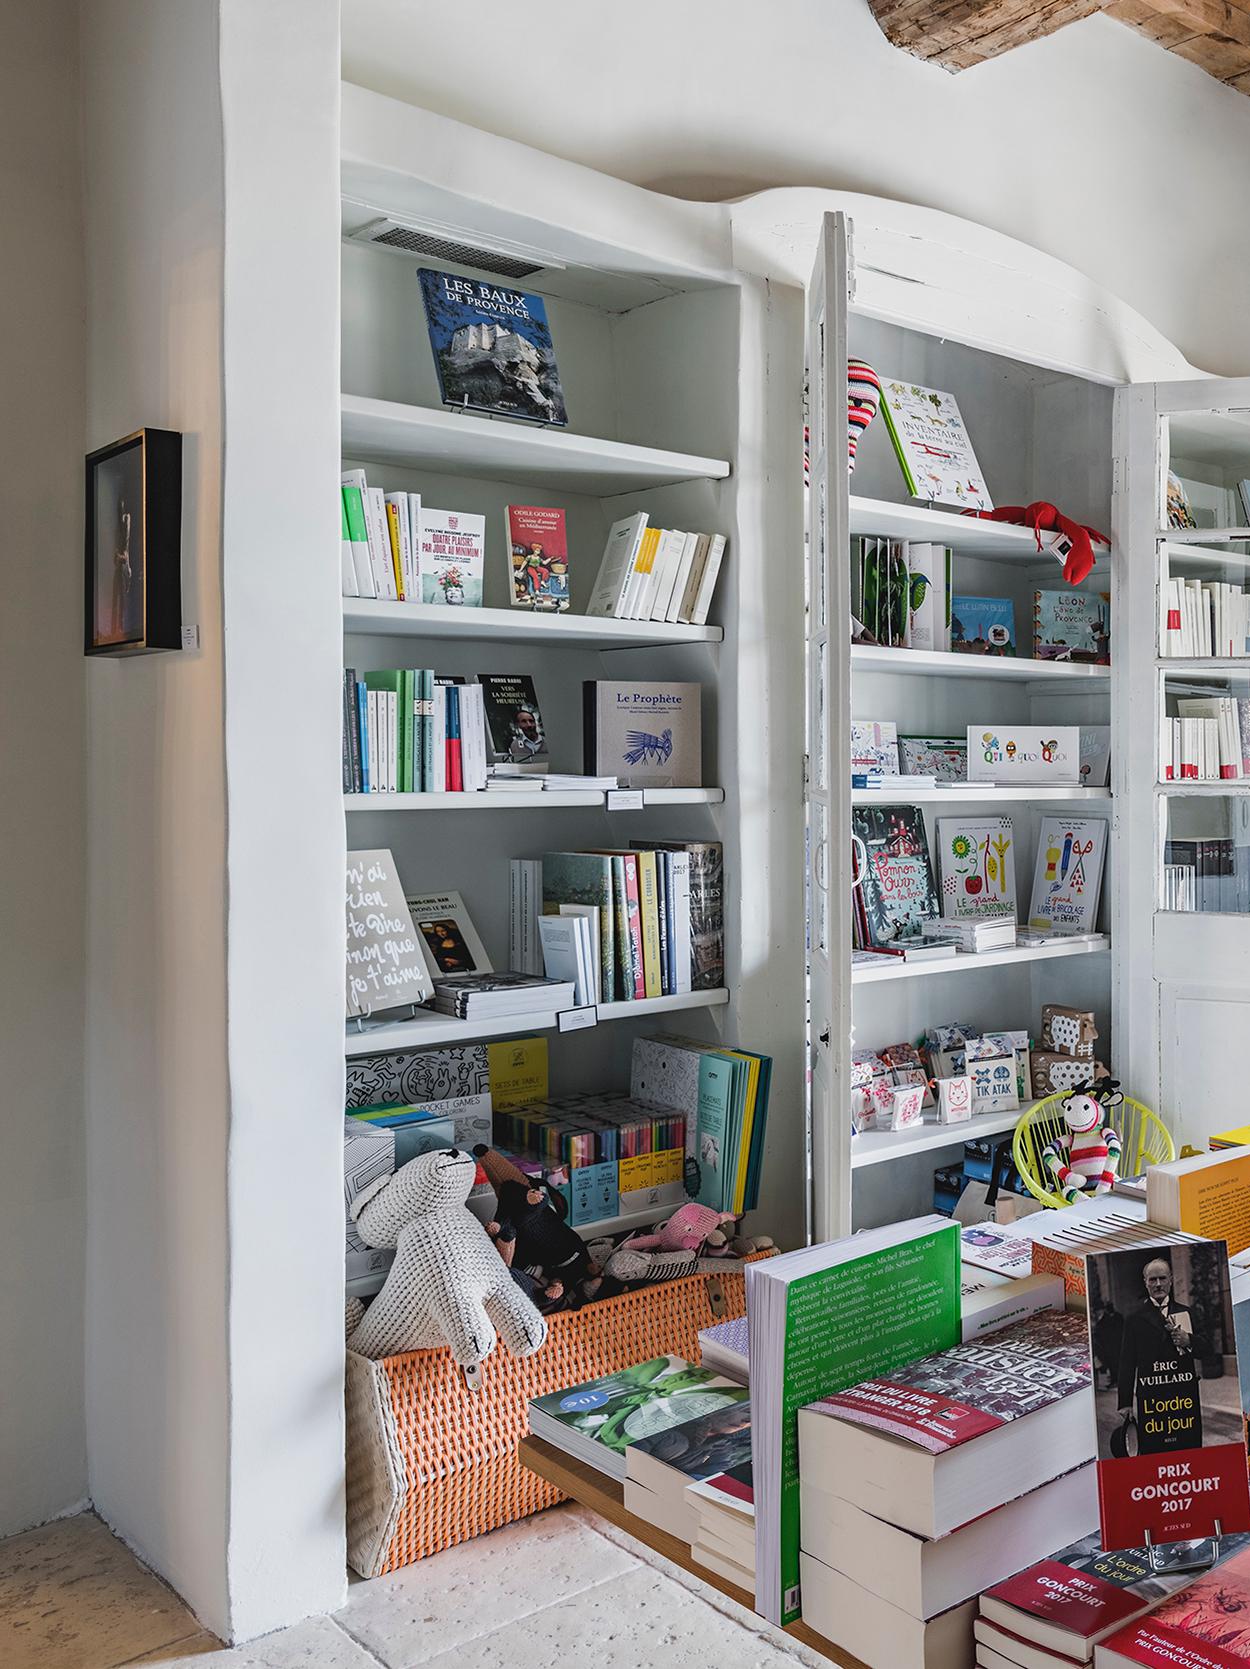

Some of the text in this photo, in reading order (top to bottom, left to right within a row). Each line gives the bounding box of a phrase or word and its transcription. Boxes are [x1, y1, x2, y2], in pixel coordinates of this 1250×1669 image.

[443, 277, 528, 309] LES BAUX
[446, 291, 463, 303] DE
[466, 296, 530, 319] PROVENCE
[902, 421, 964, 441] INVENTAIRE
[421, 542, 432, 553] PAR
[448, 545, 455, 556] AU
[455, 546, 479, 557] MINIMUM
[432, 534, 474, 547] QUATRE PLAISIRS
[617, 693, 682, 706] Le Prophète
[874, 852, 917, 883] Pompon
[689, 888, 721, 899] ARLES
[957, 898, 967, 907] LE
[1045, 896, 1051, 905] LE
[348, 912, 406, 938] te dire
[346, 939, 415, 966] inon que
[631, 927, 642, 980] Djamel Tatah
[350, 964, 423, 1007] je t'aime
[975, 1083, 1011, 1097] TIK ATAK
[453, 1096, 481, 1108] GAMES
[991, 1339, 1065, 1360] paul
[942, 1345, 1079, 1389] auster
[1152, 1360, 1178, 1372] ÉRIC
[1139, 1372, 1193, 1386] VUILLARD
[881, 1387, 900, 1396] DU
[898, 1391, 938, 1406] LIVRE
[979, 1373, 1041, 1407] 4321
[898, 1402, 931, 1416] 2018
[1143, 1396, 1194, 1414] L'ordre
[1145, 1415, 1195, 1434] du jour
[1158, 1463, 1191, 1479] PRIX
[1131, 1477, 1221, 1501] GONCOURT
[1161, 1498, 1193, 1513] 2017
[1094, 1562, 1136, 1582] du jour
[1106, 1554, 1147, 1576] L'ordre
[1036, 1576, 1106, 1608] GONCOURT
[1067, 1577, 1098, 1593] PRIX
[1044, 1591, 1073, 1605] 2017
[1135, 1638, 1153, 1650] PRIX
[1137, 1629, 1150, 1638] Par
[1150, 1633, 1177, 1651] l'auteur
[1175, 1645, 1186, 1654] de
[1185, 1650, 1212, 1666] L'Ordre
